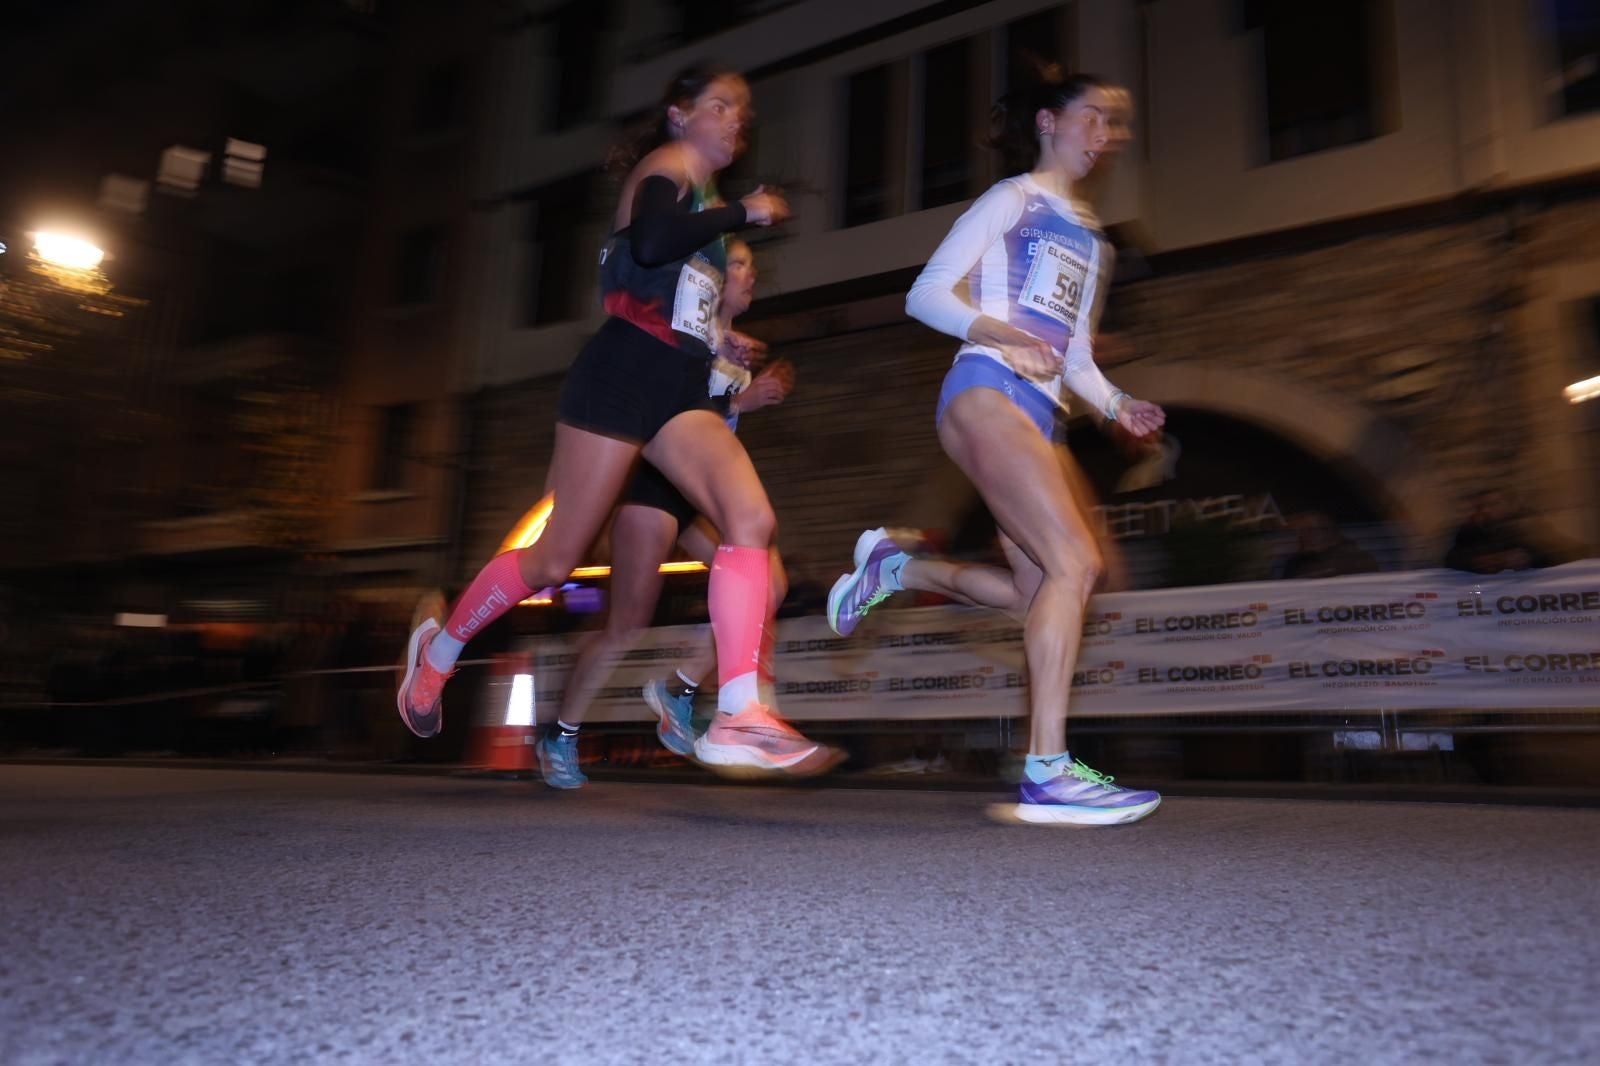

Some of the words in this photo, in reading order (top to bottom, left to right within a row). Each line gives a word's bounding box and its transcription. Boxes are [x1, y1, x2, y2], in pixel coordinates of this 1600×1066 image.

[1047, 246, 1059, 258] EL
[687, 273, 698, 285] EL
[1051, 271, 1078, 308] 59
[1032, 294, 1046, 307] EL
[696, 297, 713, 325] 5
[683, 319, 694, 331] EL
[1283, 608, 1314, 626] EL
[1317, 601, 1426, 624] CORREO
[1457, 597, 1493, 617] EL
[1496, 590, 1600, 615] CORRE
[1135, 617, 1161, 634] EL
[1163, 611, 1258, 632] CORREO
[1568, 615, 1593, 625] CON
[1287, 661, 1319, 679] EL
[1321, 657, 1433, 677] CORREO
[1463, 655, 1501, 673] EL
[1503, 652, 1600, 672] CORRE
[887, 677, 911, 692] EL
[911, 674, 986, 691] CORREO
[1137, 667, 1164, 683] EL
[1167, 663, 1263, 682] CORREO
